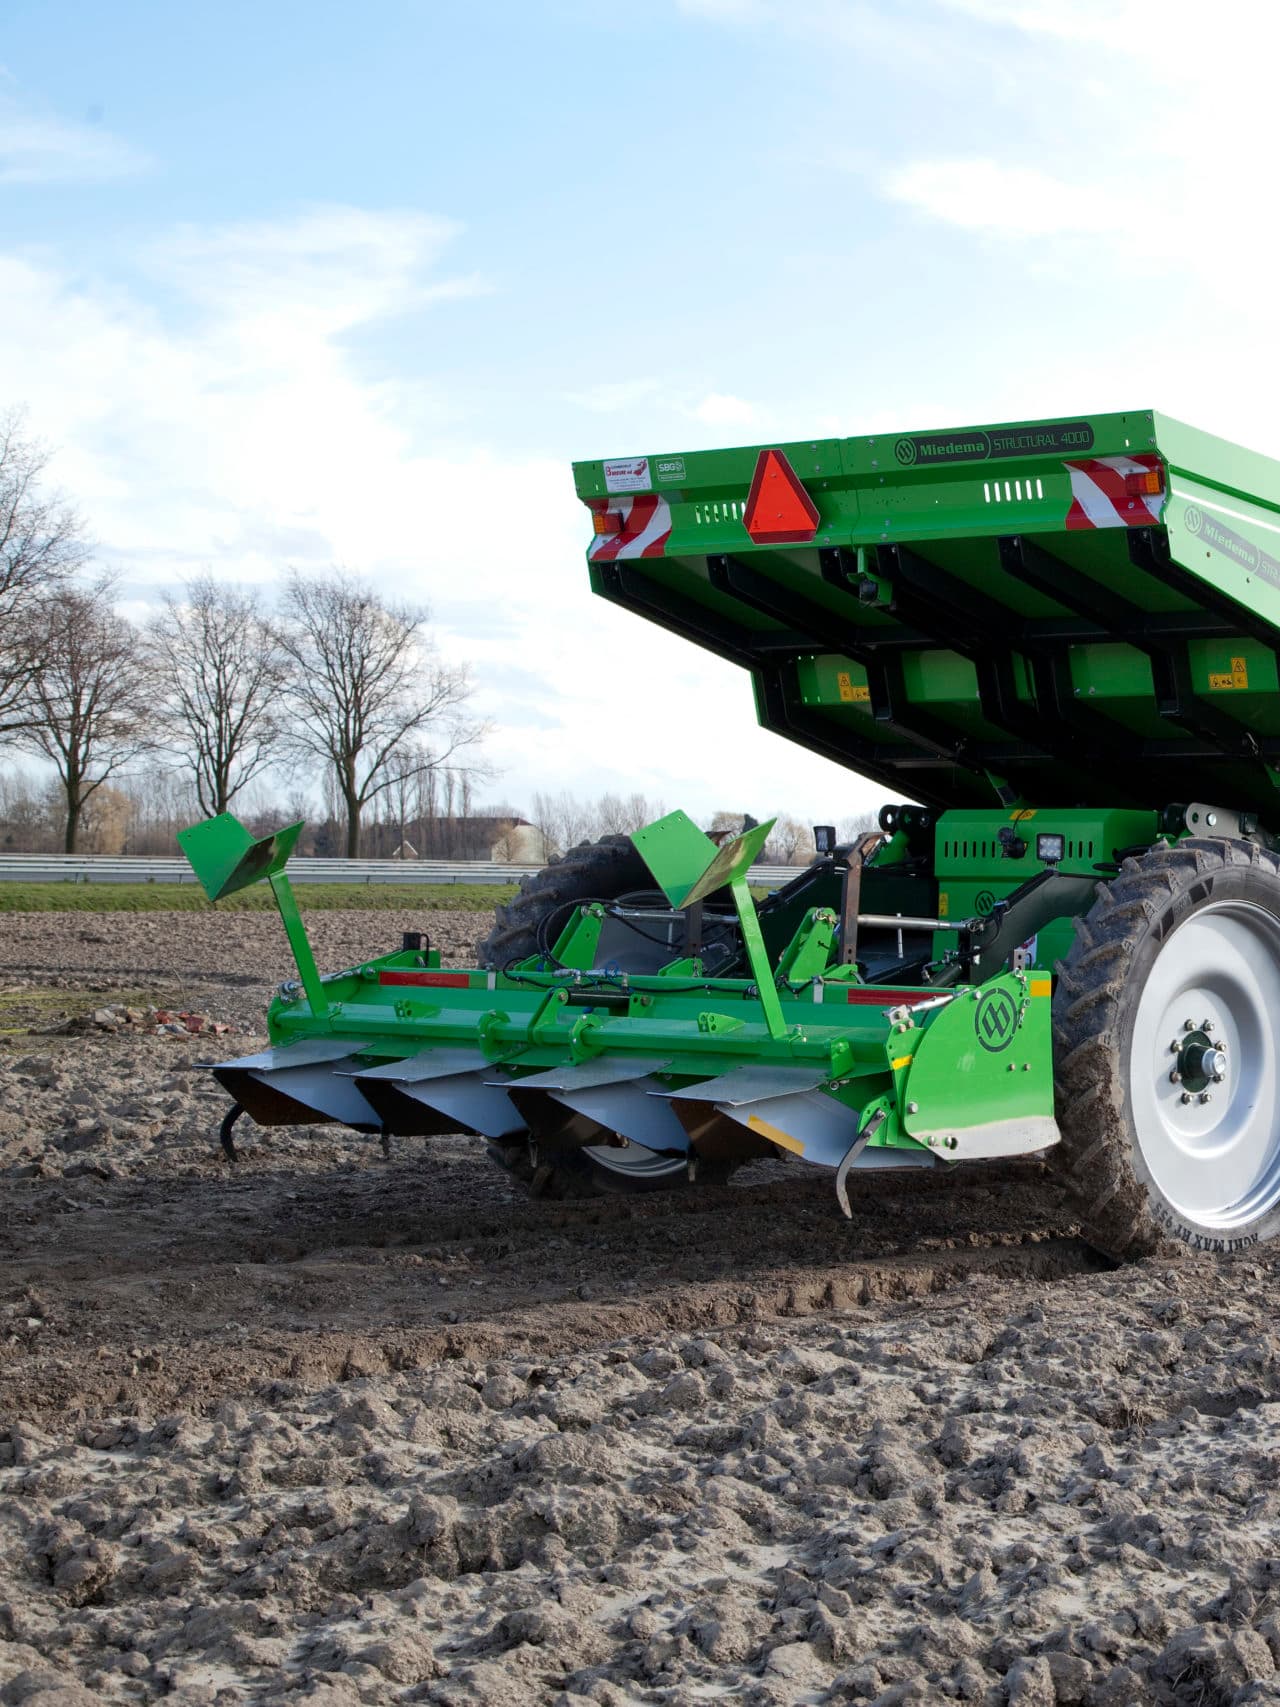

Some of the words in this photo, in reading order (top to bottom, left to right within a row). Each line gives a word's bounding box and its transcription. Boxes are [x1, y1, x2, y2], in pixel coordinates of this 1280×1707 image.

[920, 442, 985, 457] Miedema
[993, 433, 1059, 450] STRUCTURAL
[1060, 430, 1090, 445] 4000
[658, 462, 676, 472] SBG
[1203, 524, 1256, 566] Miedema
